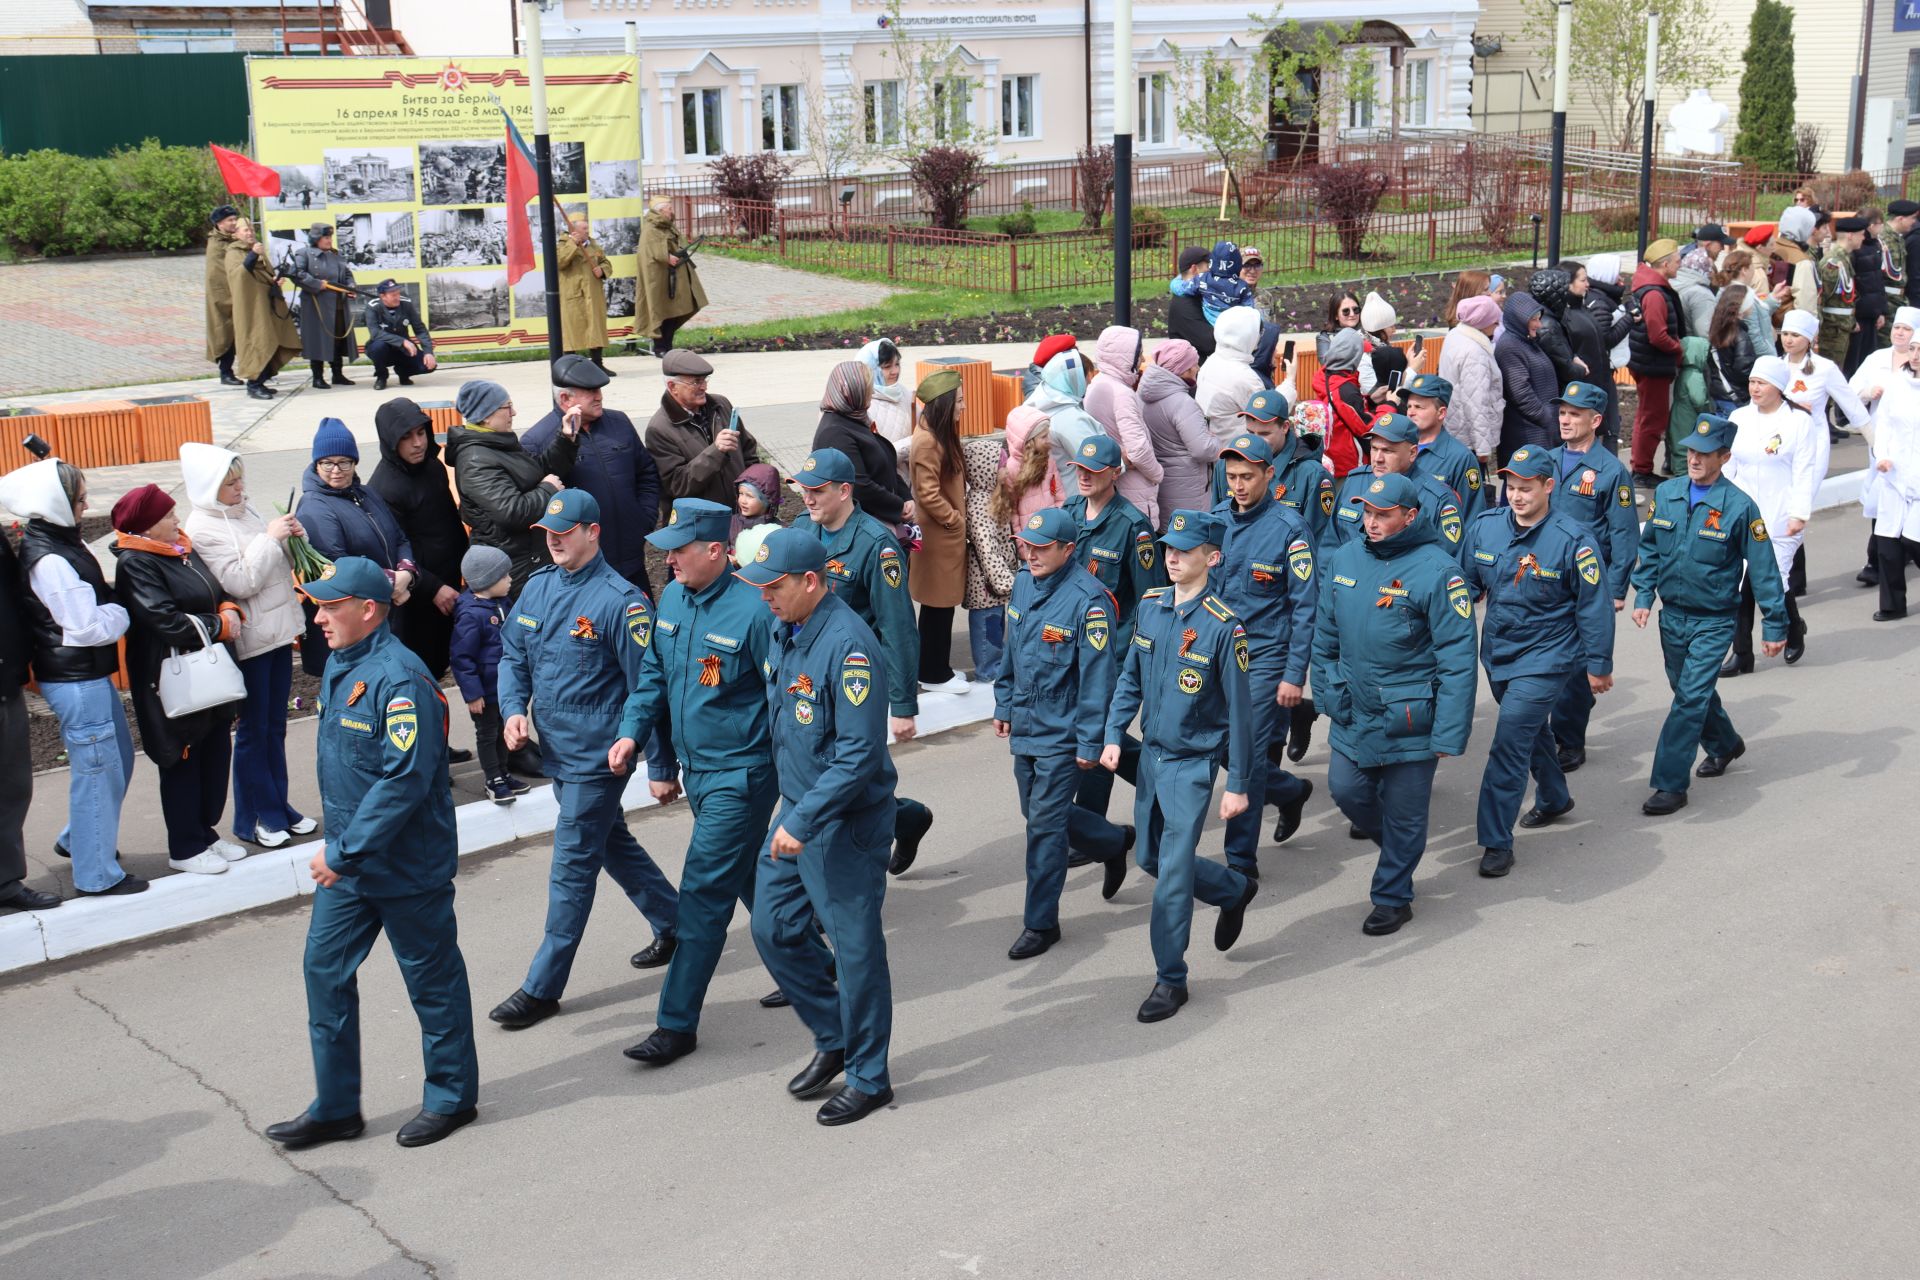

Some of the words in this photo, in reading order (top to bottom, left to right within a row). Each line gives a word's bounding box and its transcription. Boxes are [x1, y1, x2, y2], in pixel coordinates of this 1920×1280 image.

[950, 15, 974, 24] ФОНД
[1014, 14, 1036, 23] ФОНД
[402, 95, 438, 105] Битва
[440, 96, 454, 104] за
[458, 94, 501, 105] Берлин
[337, 109, 349, 119] 16
[353, 110, 398, 120] апреля
[403, 107, 429, 118] 1945
[433, 108, 460, 117] года
[471, 106, 480, 117] 8
